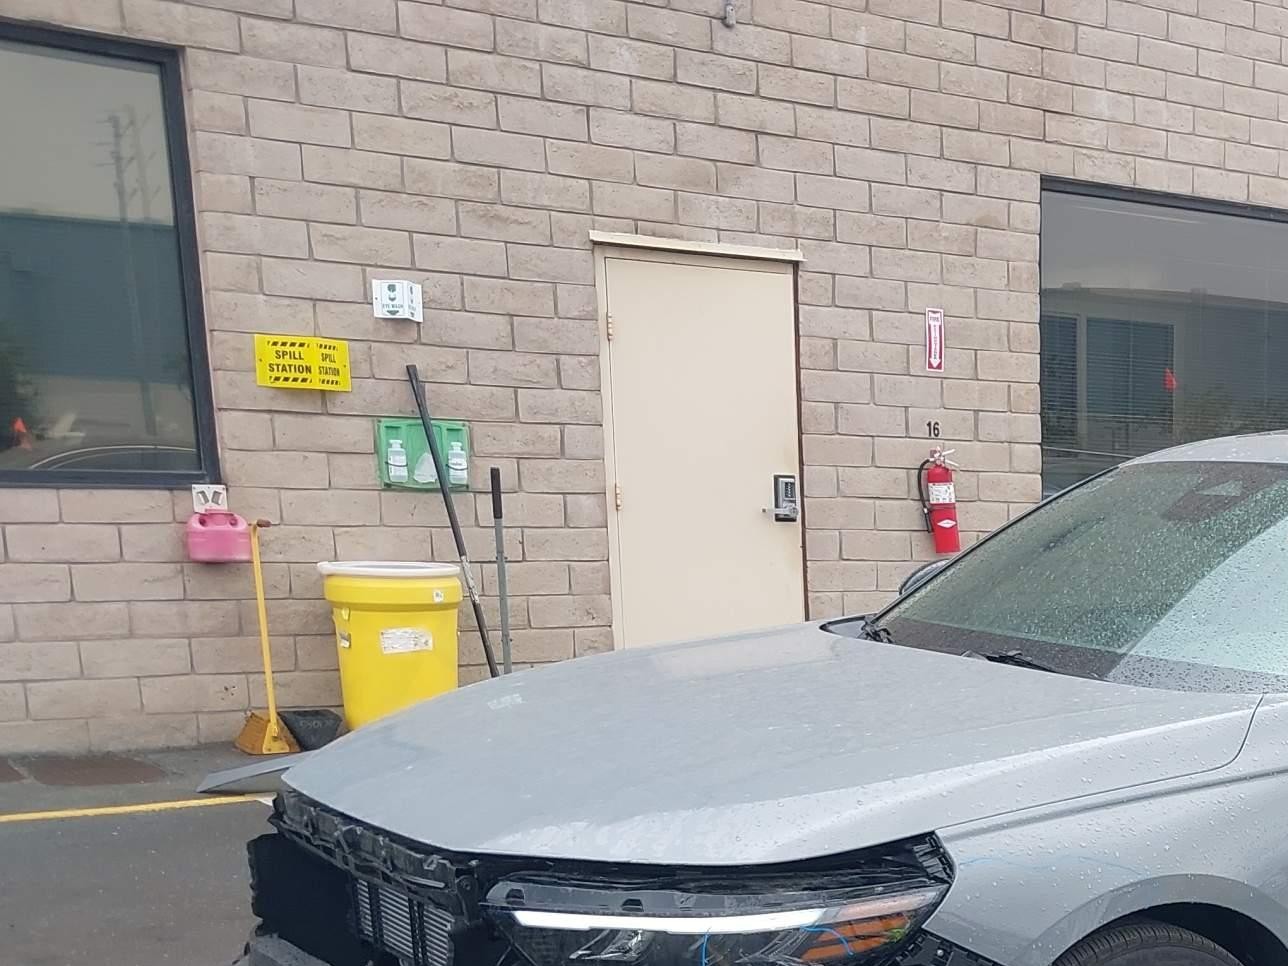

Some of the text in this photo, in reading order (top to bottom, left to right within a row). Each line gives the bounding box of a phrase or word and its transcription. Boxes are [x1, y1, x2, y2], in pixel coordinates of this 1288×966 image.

[275, 350, 304, 361] SPILL
[321, 353, 336, 363] SPILL
[268, 363, 312, 374] STATION
[318, 366, 340, 377] STATION
[926, 421, 940, 437] 16
